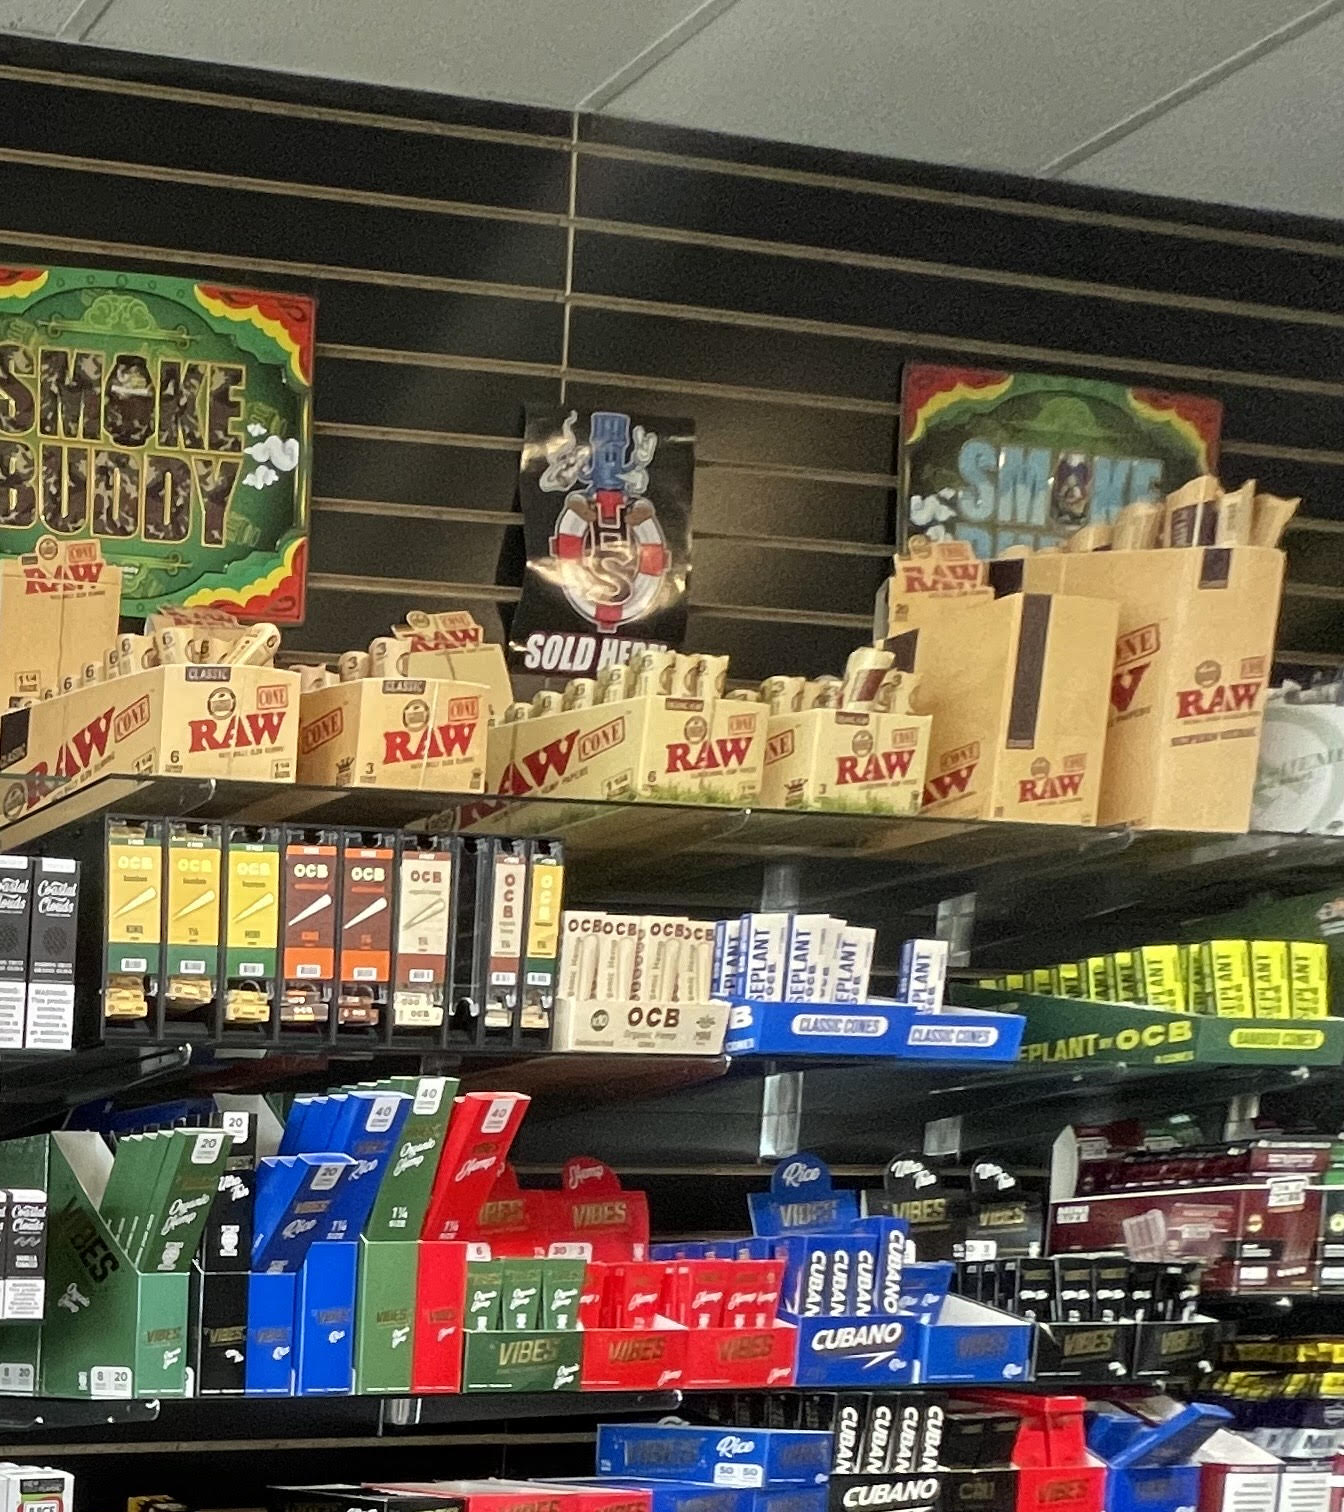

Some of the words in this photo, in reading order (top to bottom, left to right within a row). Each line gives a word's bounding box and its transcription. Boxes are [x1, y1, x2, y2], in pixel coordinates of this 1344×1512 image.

[957, 438, 1163, 524] SMOKE
[524, 634, 596, 671] SOLD
[188, 668, 229, 681] CLASSIC
[259, 688, 287, 706] CONE
[451, 700, 478, 718] CONE
[1176, 682, 1262, 719] RAW
[117, 699, 148, 738] CONE
[189, 711, 287, 752] RAW
[383, 722, 477, 764] RAW
[581, 721, 623, 757] CONE
[666, 737, 753, 773] RAW
[836, 749, 916, 785] RAW
[1018, 773, 1084, 803] RAW
[293, 863, 329, 879] OCB
[351, 866, 385, 882] OCB
[409, 870, 442, 883] OCB
[568, 918, 603, 933] OCB
[627, 1007, 681, 1028] OCB
[798, 1018, 840, 1032] CLASSIC
[1117, 1021, 1193, 1050] OCB
[421, 1088, 438, 1100] 40
[375, 1105, 392, 1118] 40
[570, 1201, 627, 1228] VIBES
[888, 1229, 903, 1315] CUBANO
[609, 1336, 666, 1363] VIBES
[811, 1321, 901, 1352] CUBANO
[499, 1338, 559, 1365] VIBES
[842, 1477, 939, 1510] CUBANO
